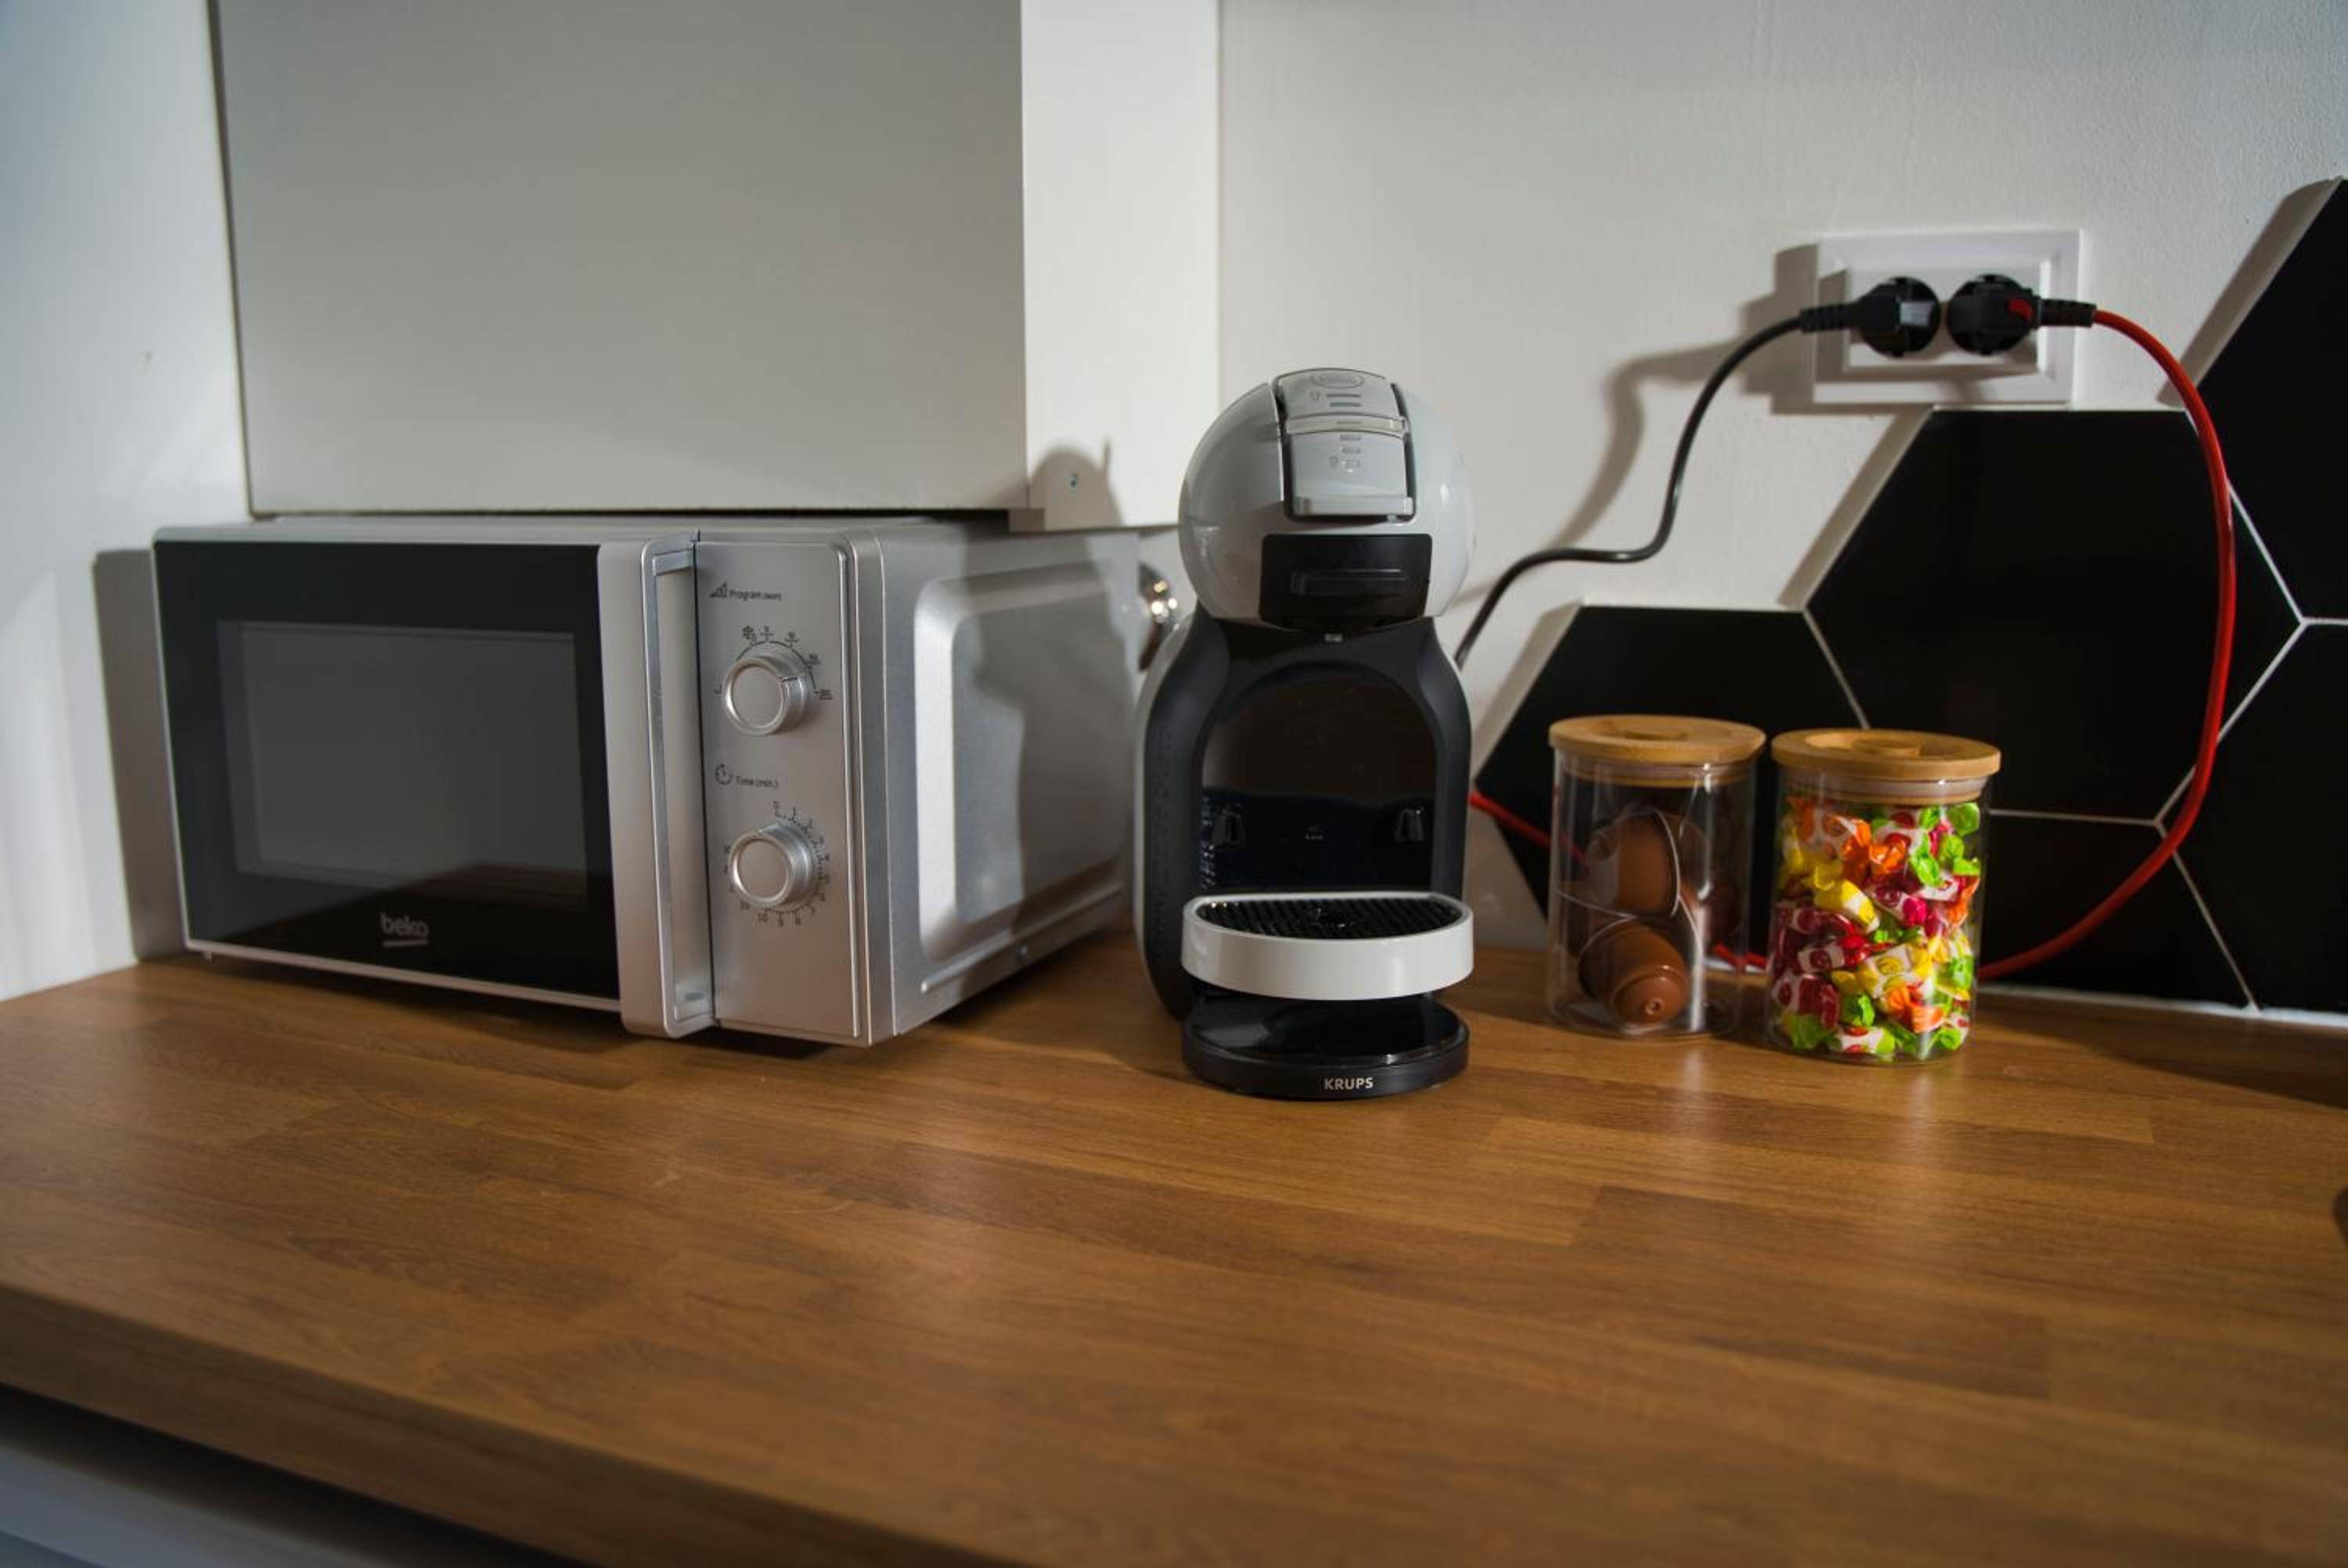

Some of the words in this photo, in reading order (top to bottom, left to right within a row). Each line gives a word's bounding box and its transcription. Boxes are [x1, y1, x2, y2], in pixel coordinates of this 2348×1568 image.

[736, 775, 754, 786] Time
[380, 912, 429, 937] beko
[1324, 1077, 1374, 1089] KRUPS
